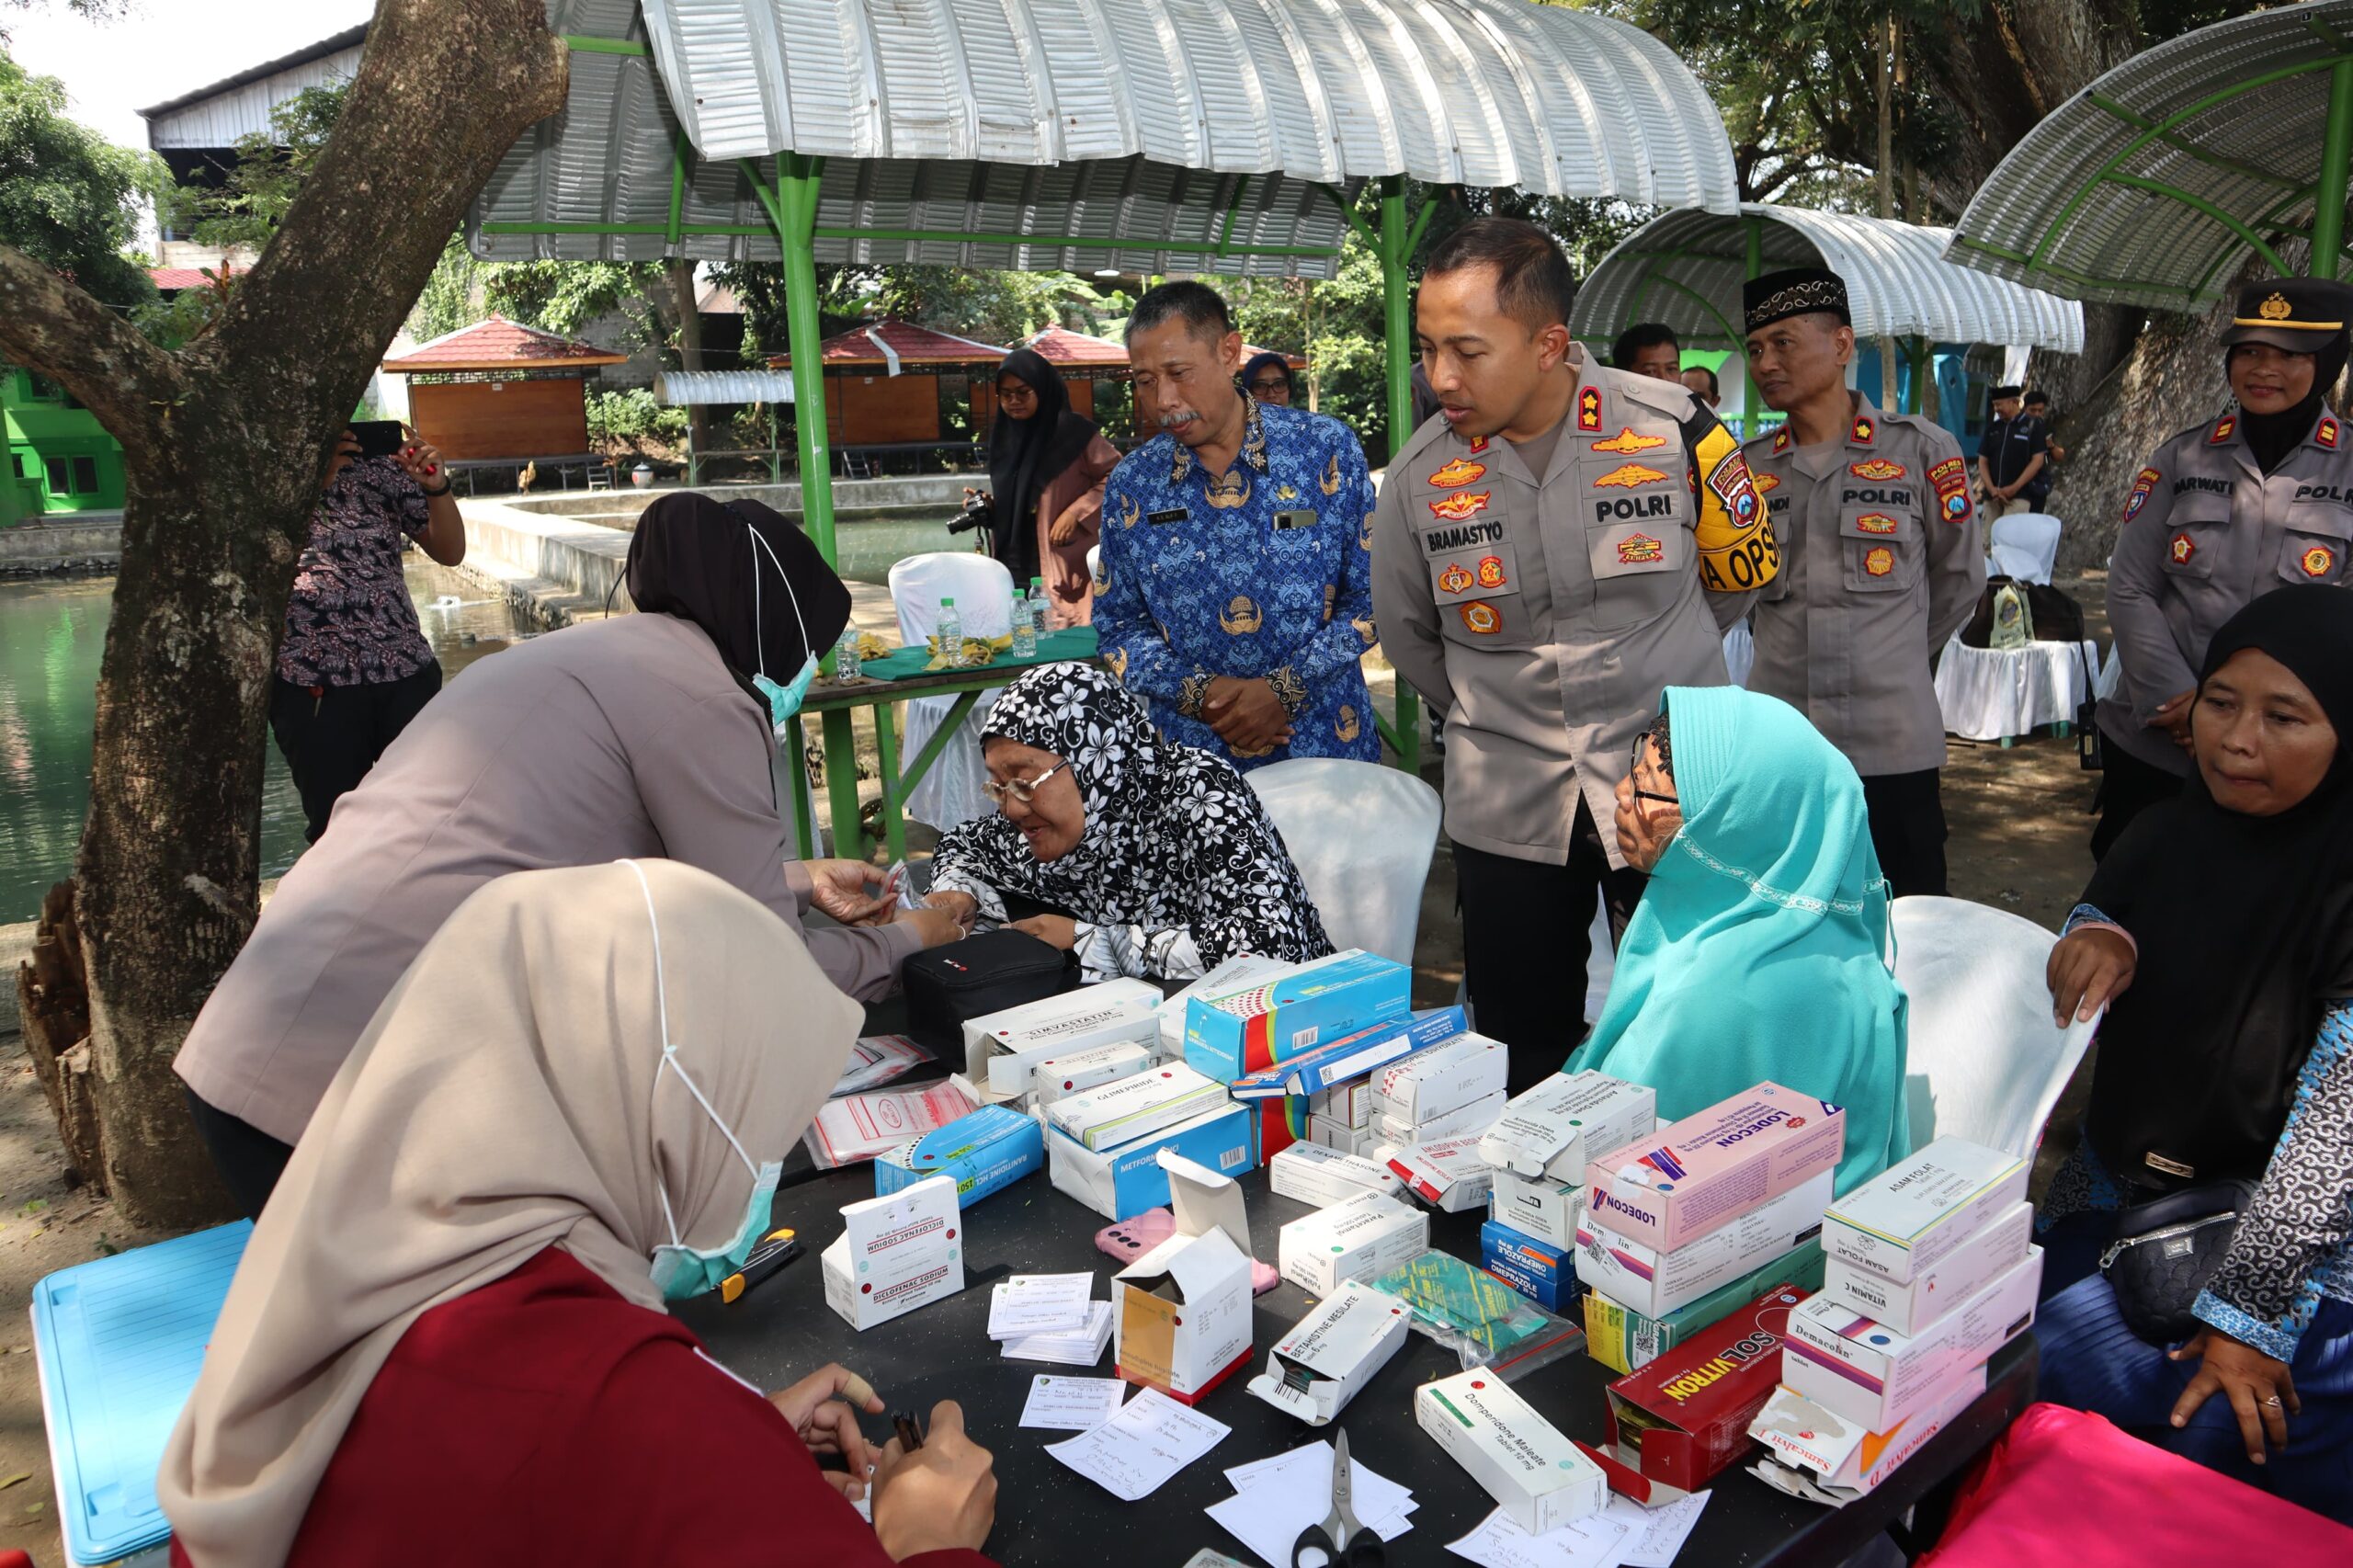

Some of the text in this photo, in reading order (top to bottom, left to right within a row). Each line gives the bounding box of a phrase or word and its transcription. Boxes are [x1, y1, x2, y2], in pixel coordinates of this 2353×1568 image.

[1931, 460, 1961, 478] POLRES
[1596, 494, 1672, 523] POLRI
[1767, 497, 1790, 513] NDI
[1843, 489, 1910, 506] POLRI
[1427, 520, 1503, 552] BRAMASTYO
[1729, 520, 1780, 587] OPS
[1029, 1010, 1112, 1036] SIMVASTATIN
[1097, 1078, 1155, 1101] GLIMEPIRIDE
[1573, 1091, 1618, 1114] Antasida Doen
[1514, 1117, 1555, 1133] Antasida Doen
[1717, 1110, 1791, 1148] LODECON
[1463, 1135, 1483, 1147] BESILA
[989, 1154, 1028, 1180] RANITIDINE
[1120, 1153, 1158, 1173] METFORM
[1312, 1149, 1381, 1174] DEXAMETHASONE
[1889, 1163, 1935, 1192] ASAM FOLAT
[1336, 1214, 1384, 1236] Paracetamol
[1607, 1198, 1655, 1227] LODECON
[868, 1220, 944, 1252] DICLOFENAC SODIUM
[1498, 1245, 1547, 1272] OMEPRAZOLE
[1837, 1248, 1889, 1273] ASAM FOLAT
[873, 1280, 921, 1301] DICLOFENAC
[920, 1267, 949, 1283] SODIUM
[1290, 1269, 1322, 1290] Patamol
[1492, 1265, 1537, 1292] OMEPRAZOLE
[1845, 1282, 1887, 1308] VITAMIN C
[1290, 1295, 1359, 1358] BETAHISTINE MESILATE
[1303, 1342, 1327, 1363] Tablet 6 mg
[1795, 1324, 1853, 1359] Demacolin
[1790, 1355, 1809, 1369] tablet
[1465, 1392, 1515, 1440] Domperidone
[1514, 1438, 1546, 1467] Maleate
[1495, 1435, 1535, 1471] Tablet 10 mg
[1771, 1435, 1831, 1471] Samcalvit
[1870, 1421, 1940, 1487] Samcalvit D
